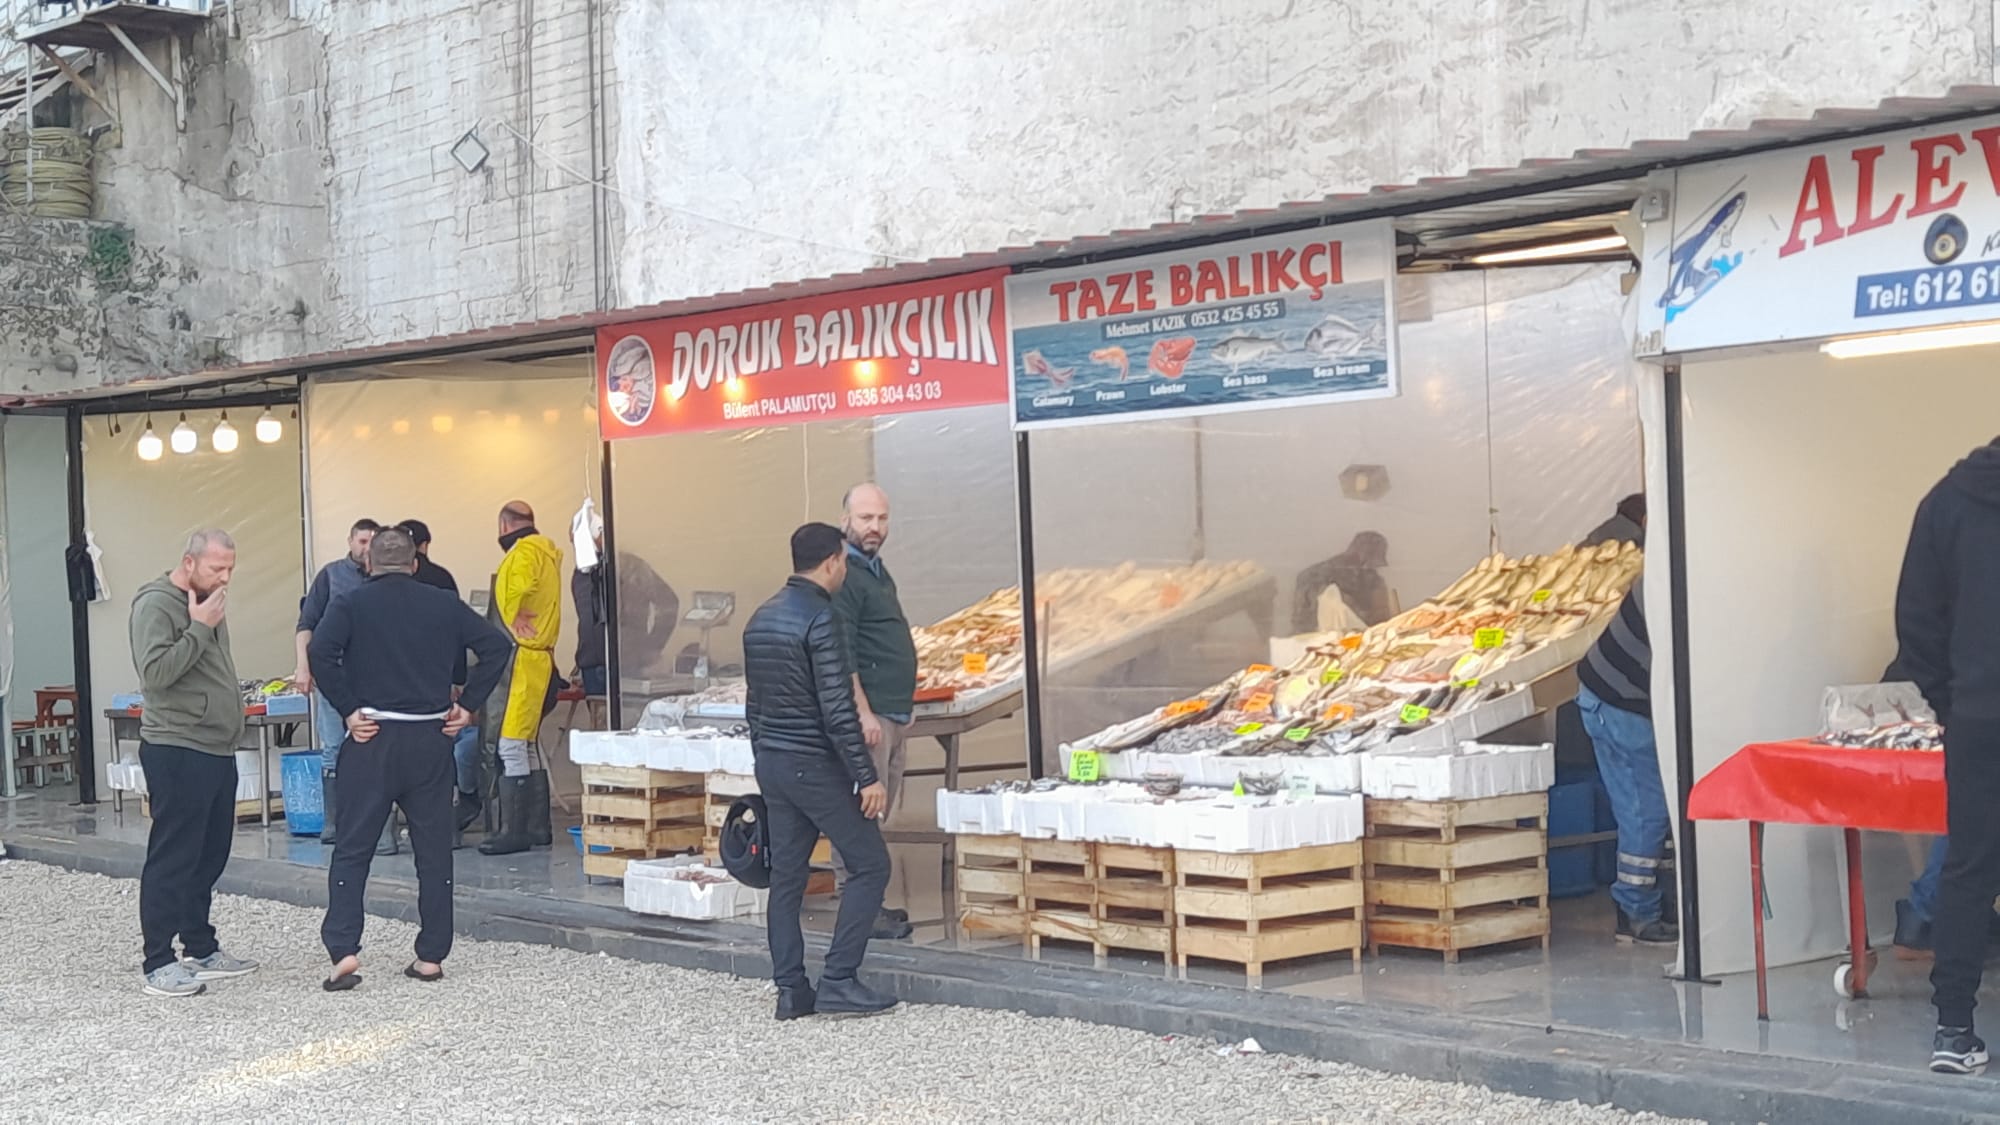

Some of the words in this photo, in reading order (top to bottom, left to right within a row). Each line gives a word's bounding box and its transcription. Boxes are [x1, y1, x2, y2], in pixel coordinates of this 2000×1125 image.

[1049, 269, 1156, 322] TAZE
[1169, 240, 1344, 302] BALIKÇI
[1866, 283, 1909, 310] Tel:
[1914, 269, 1963, 305] 612
[1106, 321, 1150, 338] Mehmet
[1152, 314, 1186, 332] KAZIK
[1190, 309, 1220, 327] 0532
[1222, 306, 1244, 322] 425
[1246, 303, 1262, 319] 45
[1263, 301, 1279, 317] 55
[671, 317, 783, 401] DORUK
[793, 288, 999, 376] BALIKÇILIK
[1150, 383, 1187, 396] Lobster
[1222, 375, 1243, 388] Sea
[1244, 373, 1268, 385] bass
[1313, 366, 1334, 379] Sea
[1336, 363, 1371, 376] bream
[723, 402, 760, 420] Bülent
[761, 392, 837, 415] PALAMUTÇU
[847, 388, 879, 408] 0536
[880, 385, 904, 403] 304
[906, 383, 922, 400] 43
[924, 381, 942, 399] 03
[1095, 390, 1125, 402] Prawn
